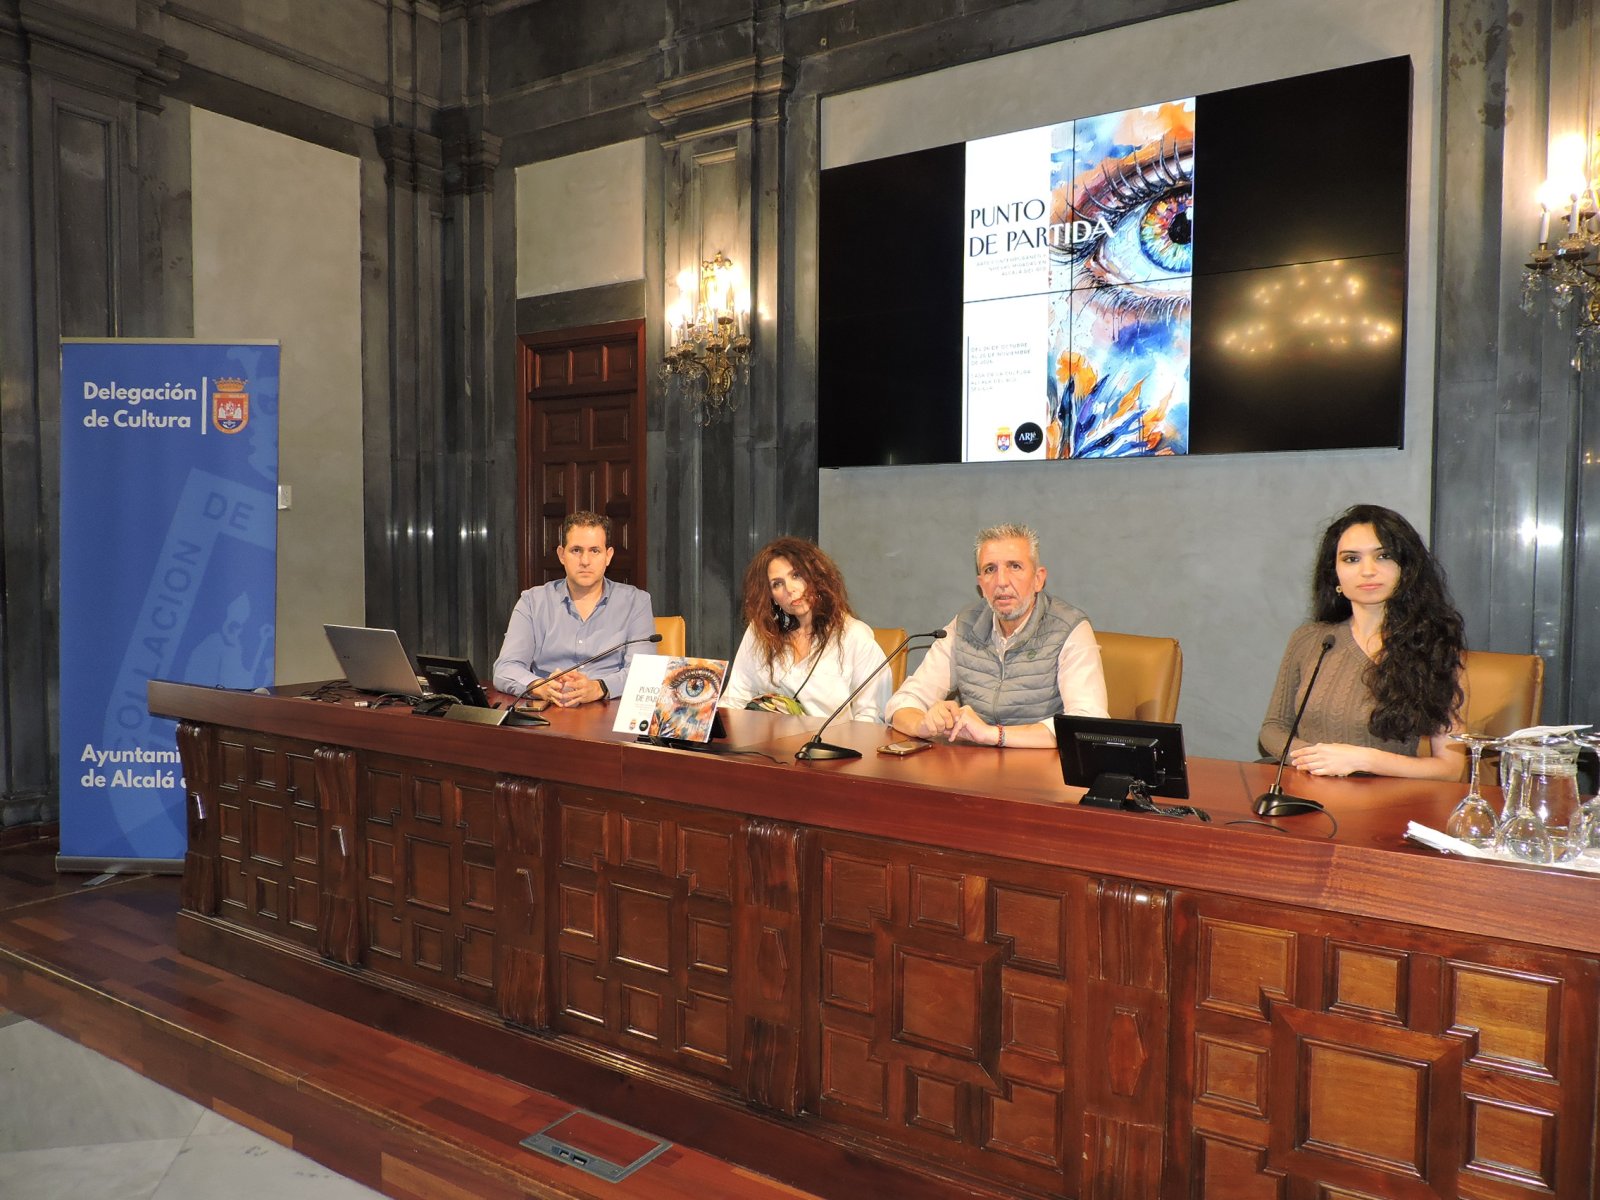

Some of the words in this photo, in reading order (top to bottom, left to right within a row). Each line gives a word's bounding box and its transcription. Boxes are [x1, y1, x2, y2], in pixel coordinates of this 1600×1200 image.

[970, 198, 1045, 229] PUNTO
[969, 233, 998, 257] DE
[1007, 216, 1116, 252] PARTIDA
[83, 381, 197, 405] Delegación
[83, 408, 109, 428] de
[113, 408, 191, 428] Cultura
[202, 491, 255, 532] DE
[80, 743, 182, 768] Ayuntami
[80, 769, 106, 788] de
[110, 769, 175, 789] Alcalá
